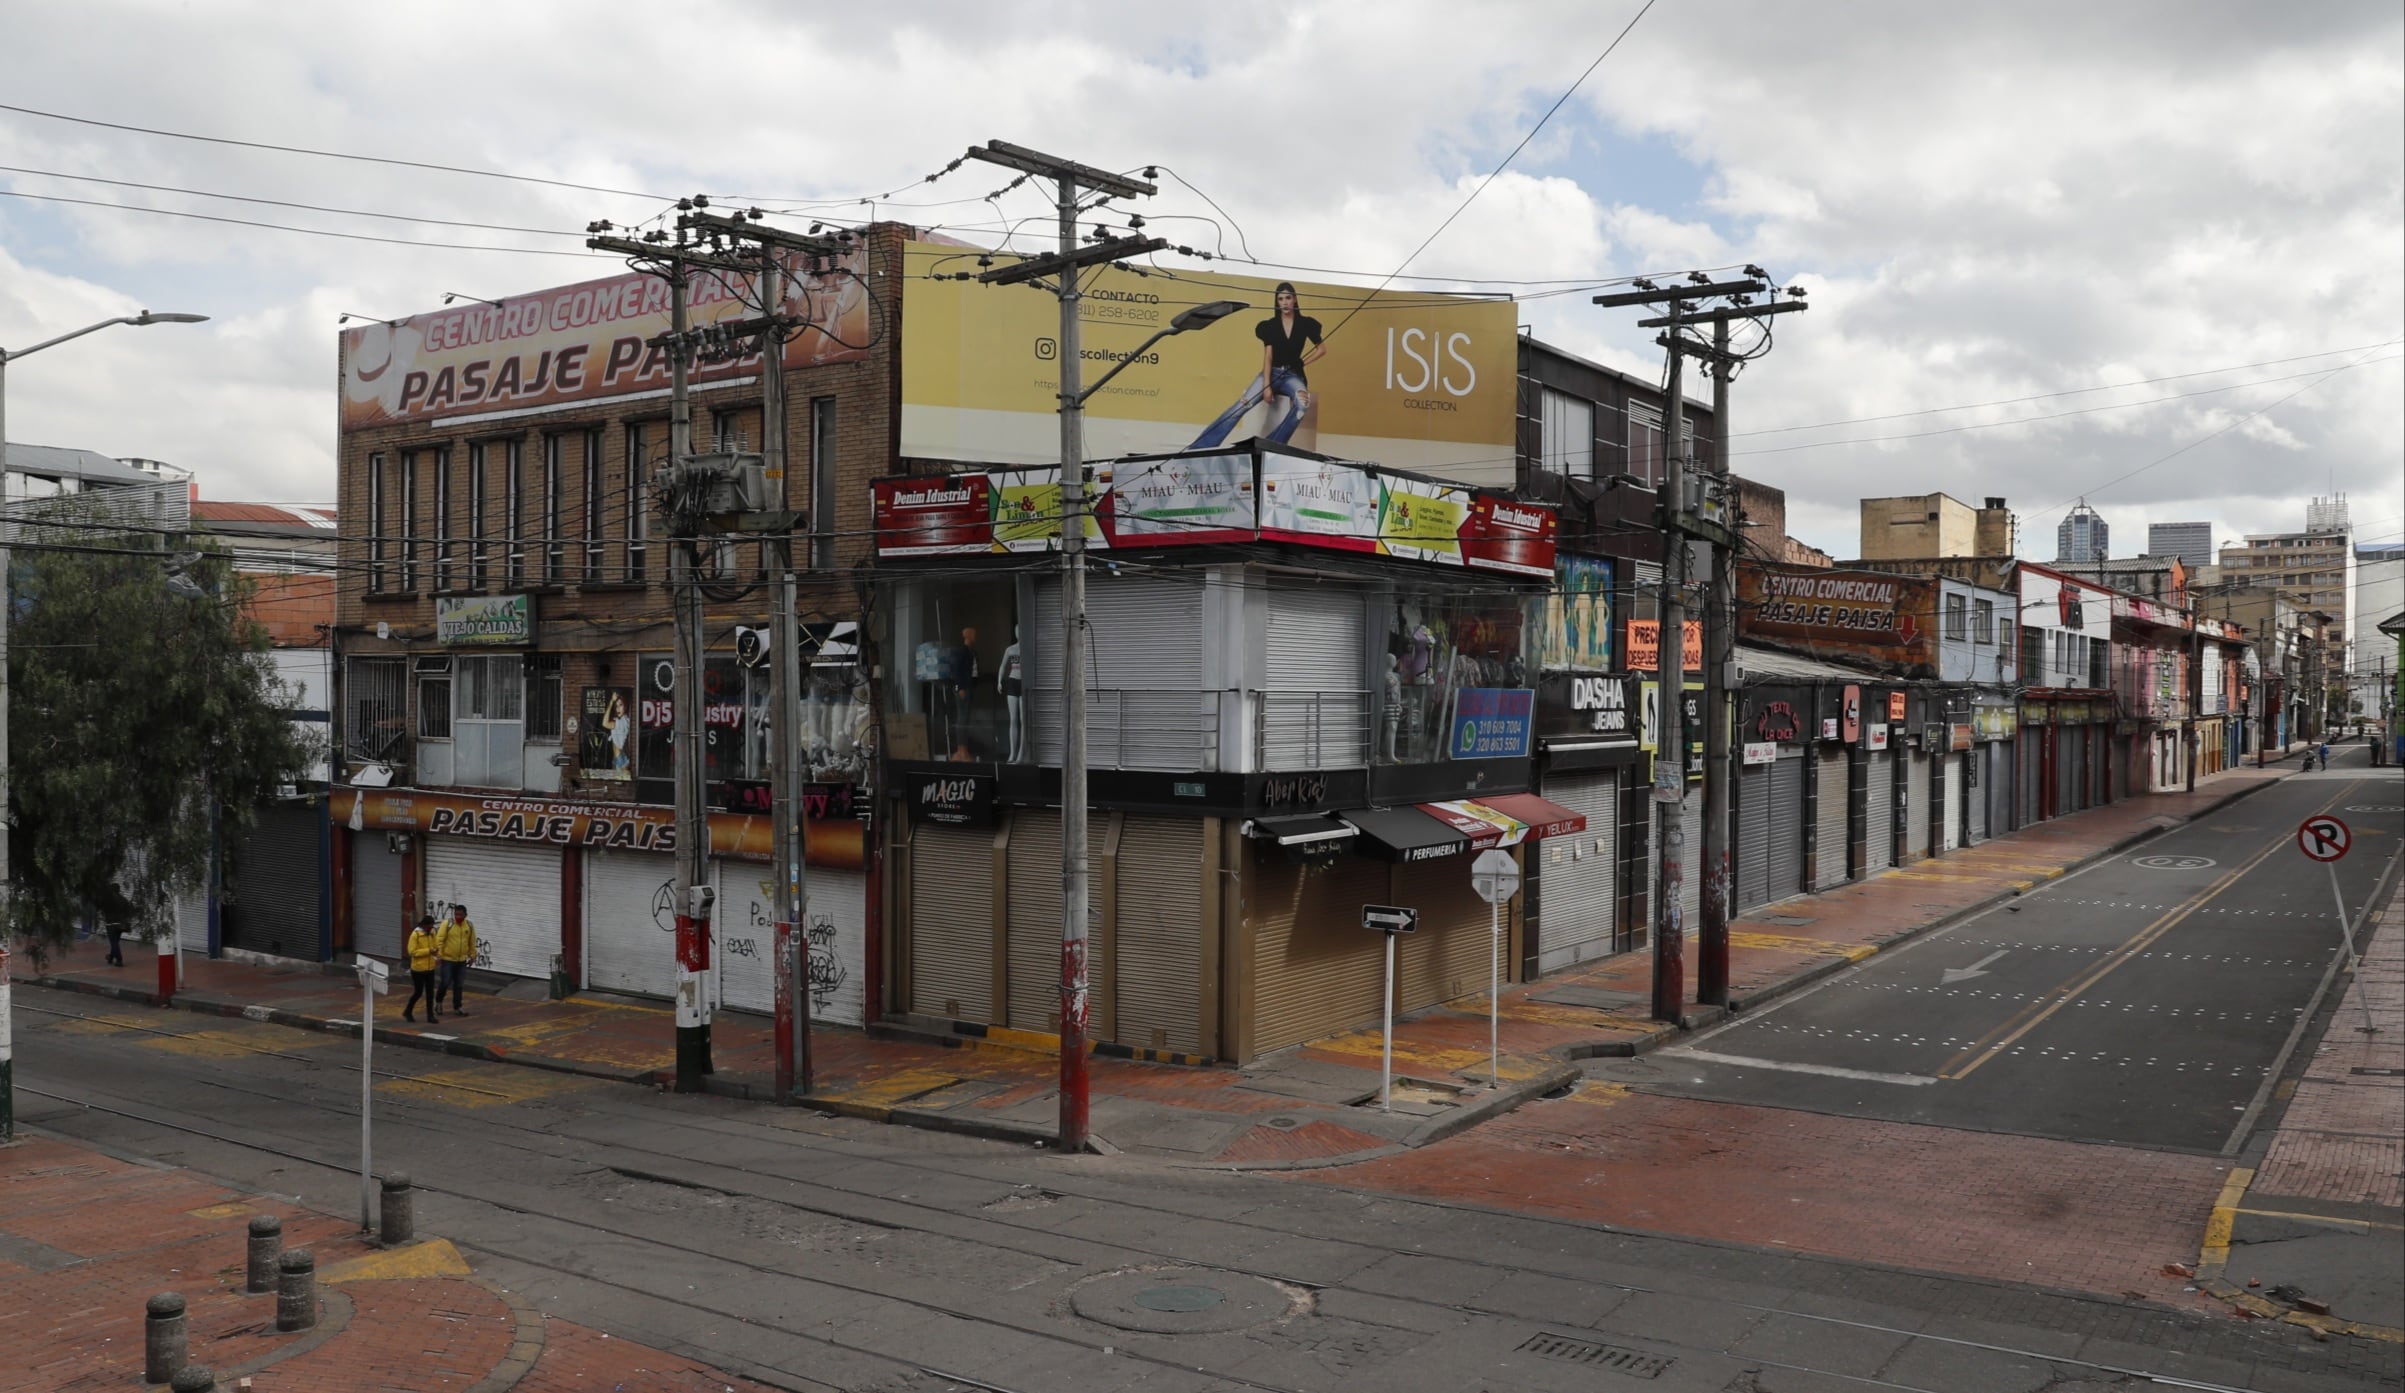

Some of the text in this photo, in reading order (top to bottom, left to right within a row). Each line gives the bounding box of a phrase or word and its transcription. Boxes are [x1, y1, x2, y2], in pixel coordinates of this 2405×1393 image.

[1091, 289, 1160, 305] CONTACTO
[1098, 305, 1160, 321] 258-6202
[425, 304, 543, 352] CENTRO
[1386, 327, 1476, 397] ISIS
[398, 344, 589, 414] PASAJE
[1403, 398, 1457, 411] COLLECTION
[893, 486, 972, 506] Denim Idustrial
[1141, 482, 1223, 498] MIAU MIAU
[1296, 484, 1352, 504] MIAU MIAU
[1491, 504, 1542, 528] Denim Idustrial
[1761, 575, 1893, 603] CENTRO COMERCIAL
[1755, 600, 1897, 631] PASAJE PAISA
[442, 620, 524, 635] VIEJO CALDAS
[1570, 677, 1625, 710] DASHA
[641, 700, 673, 726] Dj5
[1593, 711, 1625, 730] JEANS
[1478, 720, 1492, 735] 310
[1506, 719, 1522, 734] 7004
[921, 778, 976, 804] MAGIC
[482, 800, 643, 819] CENTRO COMERCIAL
[429, 808, 576, 843] PASAJE
[582, 818, 676, 852] PAIS
[1412, 844, 1456, 862] PERFUMERIA
